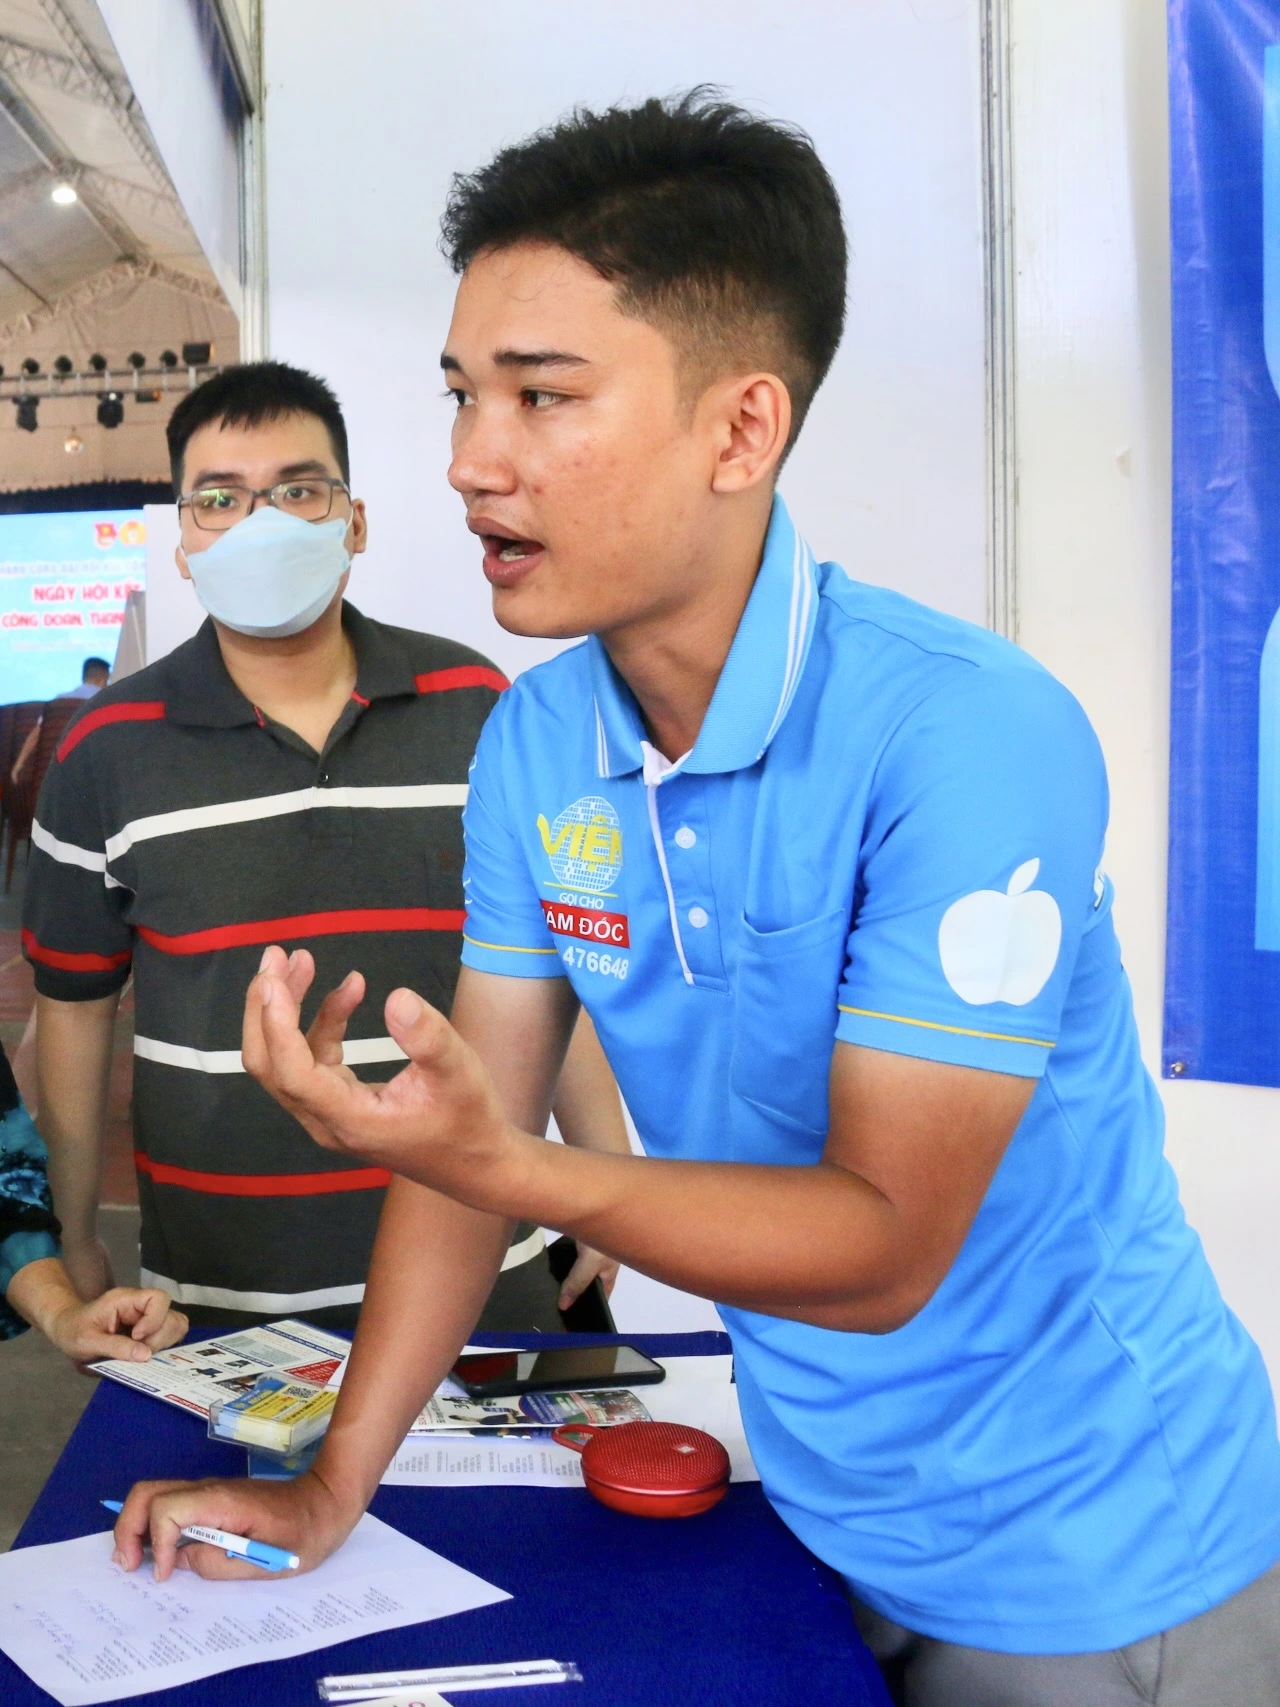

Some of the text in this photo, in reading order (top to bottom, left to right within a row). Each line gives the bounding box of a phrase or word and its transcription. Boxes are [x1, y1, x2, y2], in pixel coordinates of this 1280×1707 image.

[34, 583, 76, 601] NGÀY
[82, 582, 108, 602] HỘI
[2, 609, 39, 628] CÔNG
[559, 892, 604, 910] GỌI CHO
[542, 908, 624, 942] ÁM ĐỐC
